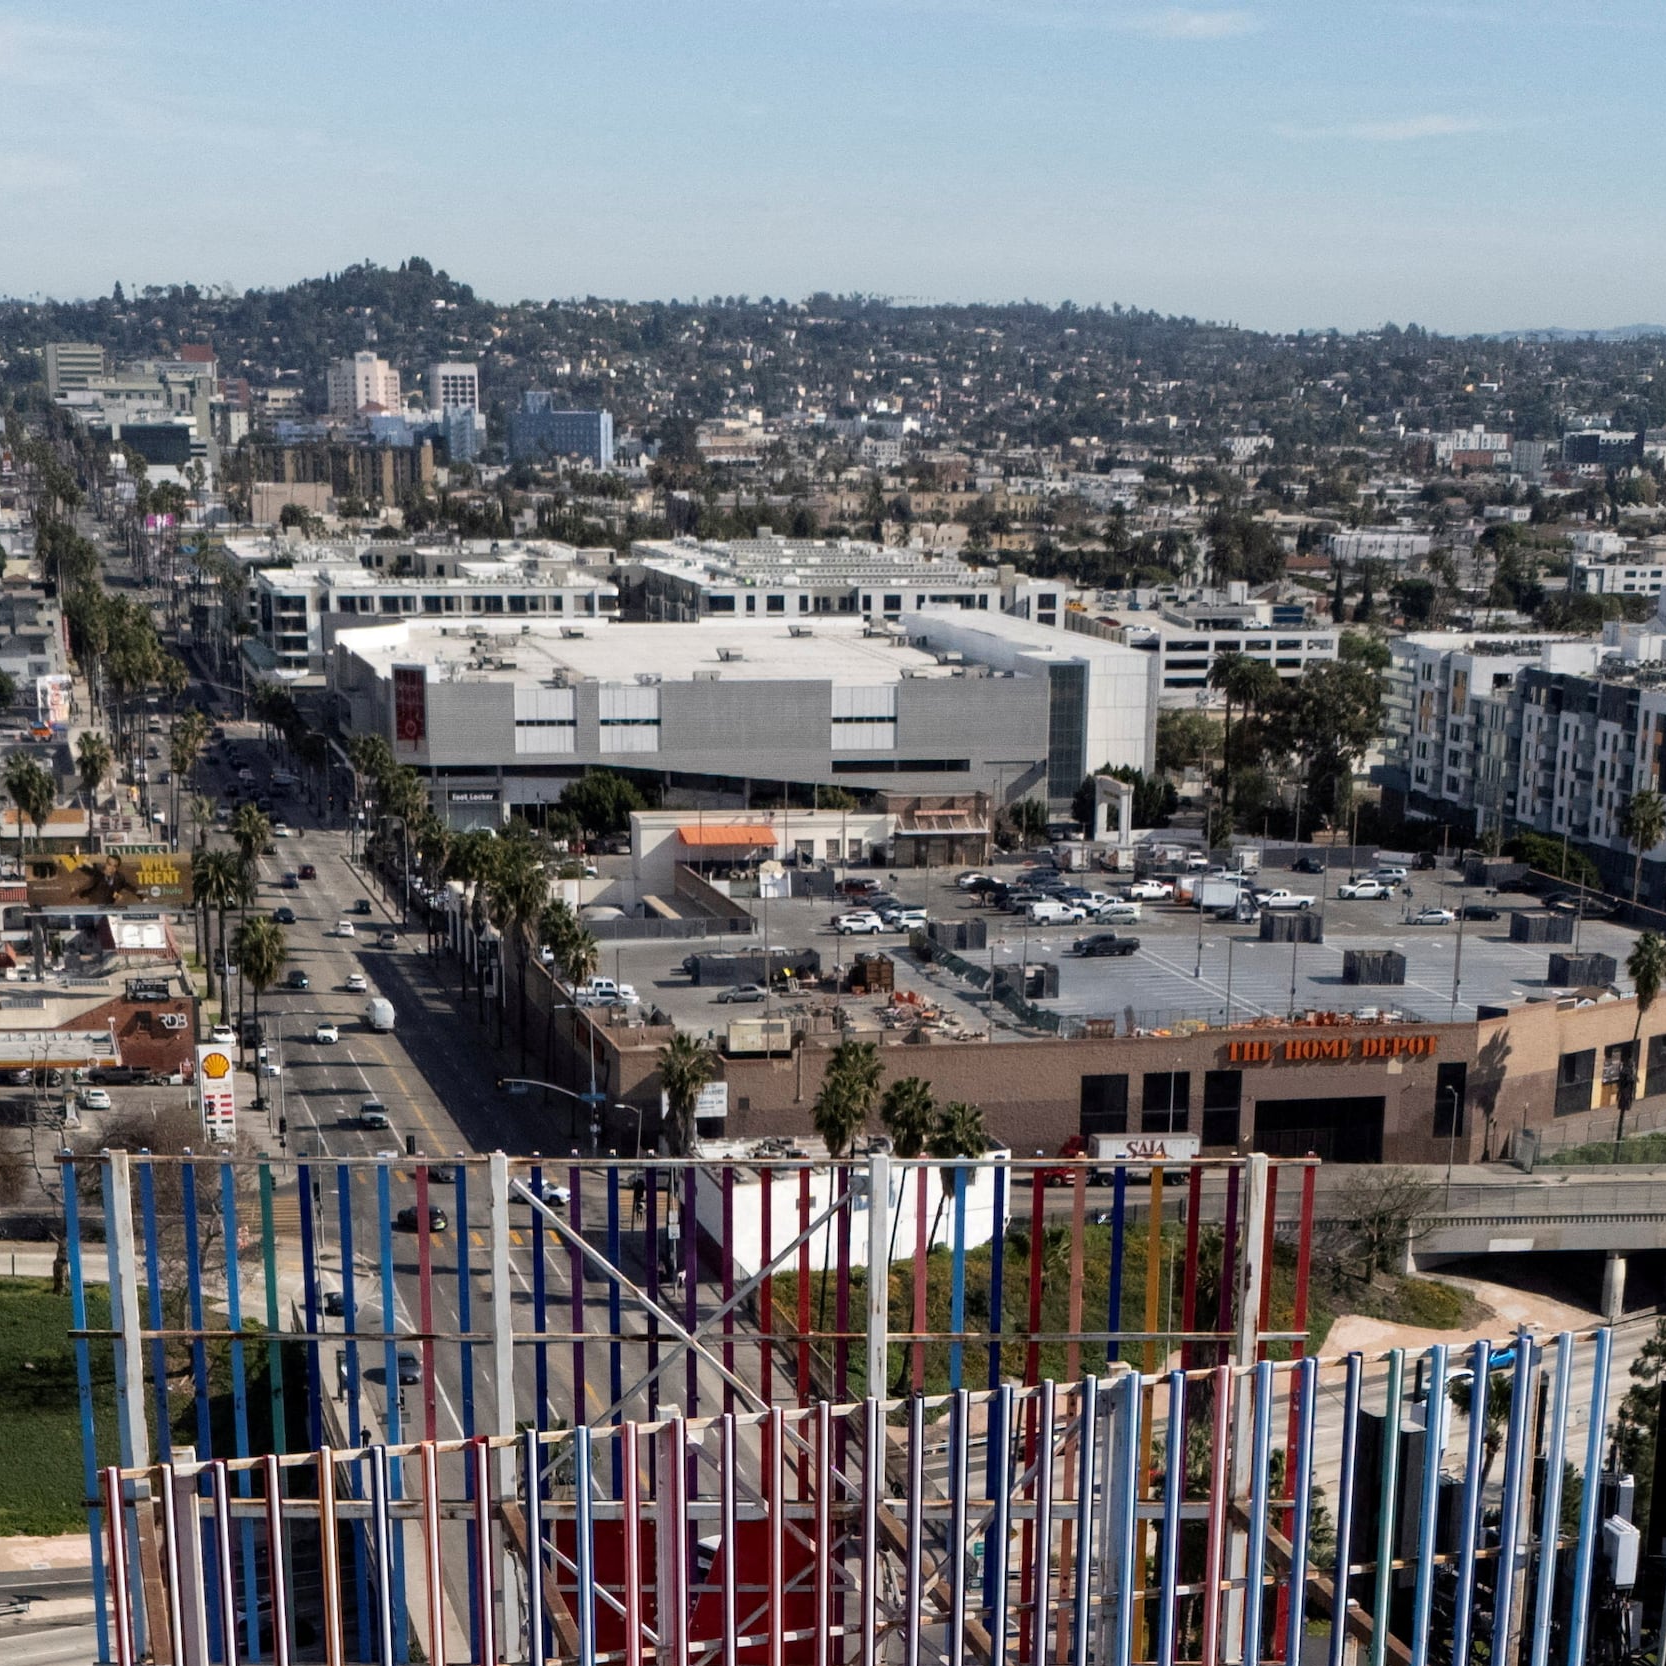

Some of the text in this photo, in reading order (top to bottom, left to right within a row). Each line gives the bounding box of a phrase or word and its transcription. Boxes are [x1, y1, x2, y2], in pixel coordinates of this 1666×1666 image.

[452, 793, 493, 801] Foot Locker
[109, 846, 164, 855] DUNES
[141, 855, 176, 871] WILL
[136, 871, 180, 885] TRENT
[1228, 1035, 1438, 1062] THE HOME DEPOT
[1126, 1140, 1167, 1158] SAIA
